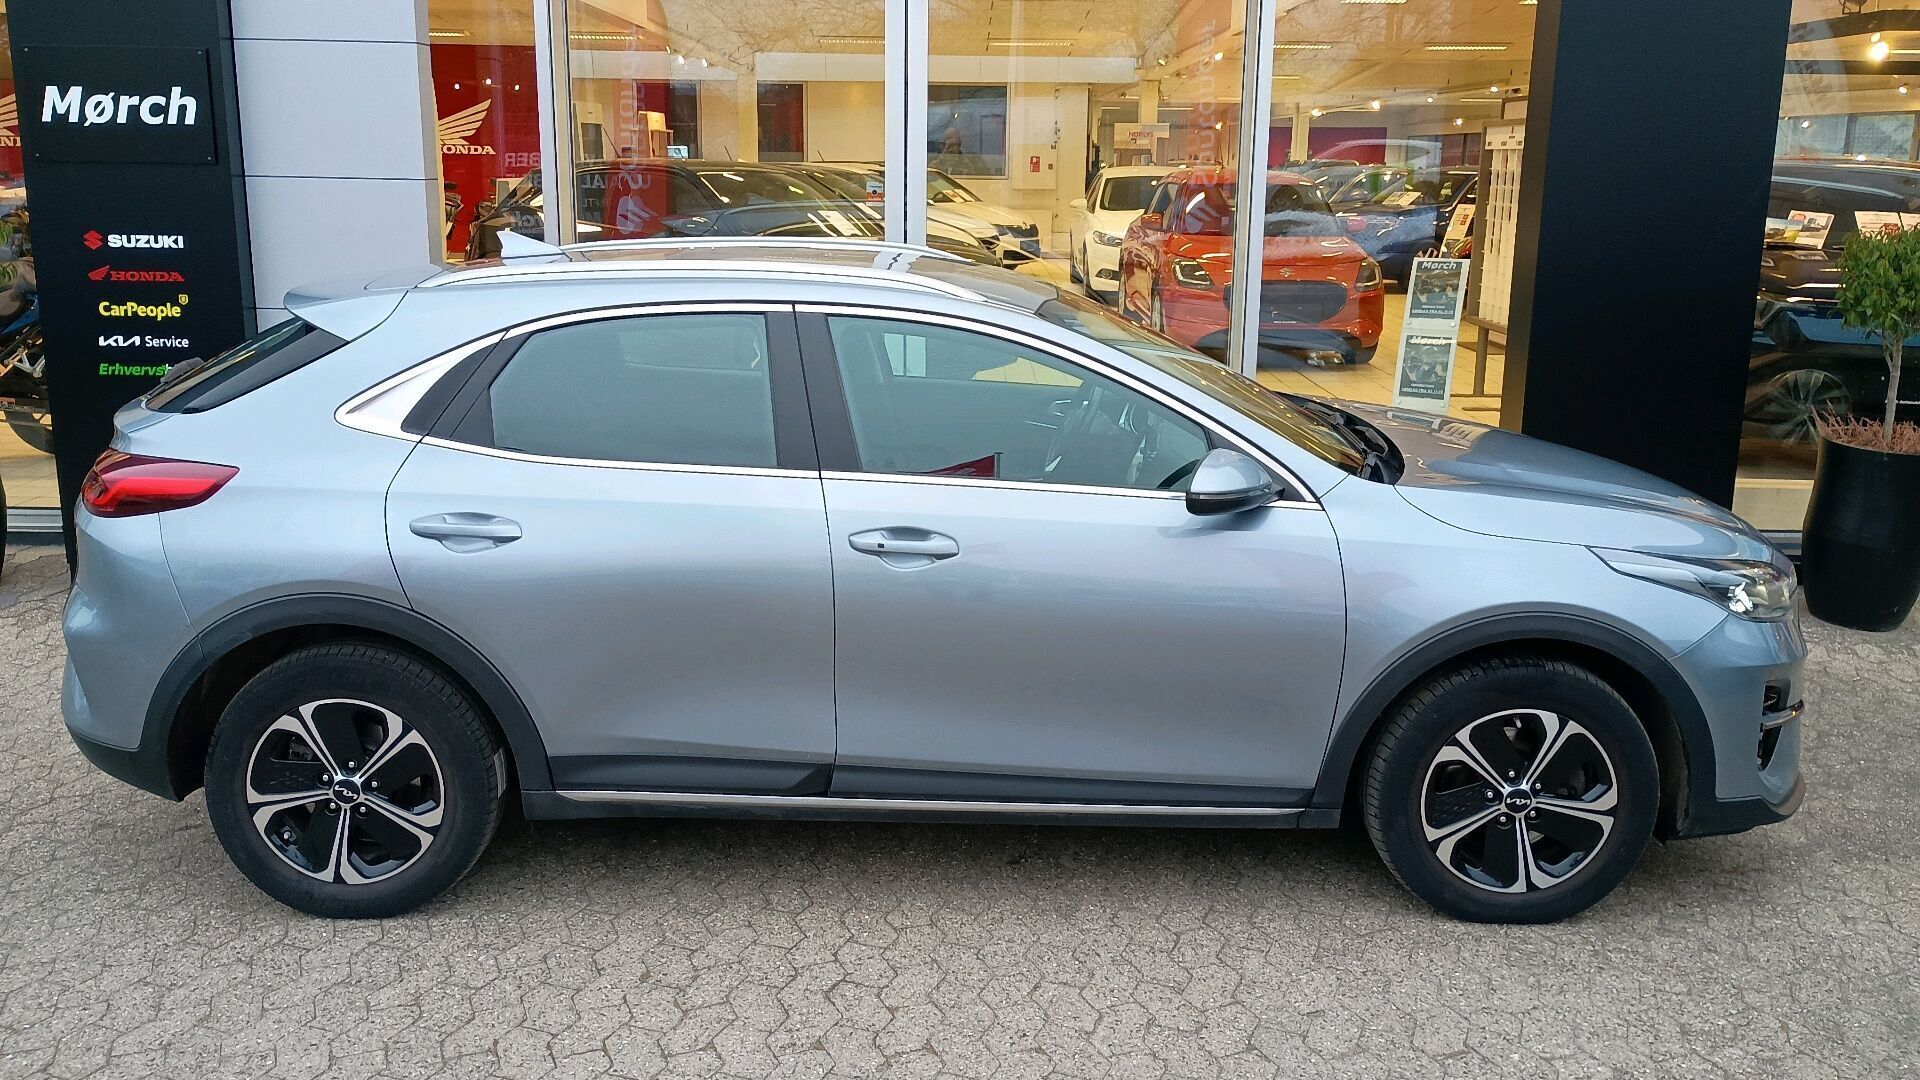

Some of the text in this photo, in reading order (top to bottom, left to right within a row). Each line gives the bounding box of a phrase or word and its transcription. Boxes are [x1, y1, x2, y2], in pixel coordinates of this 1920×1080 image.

[41, 85, 198, 127] Mørch
[440, 144, 496, 155] ONDA
[107, 234, 184, 249] SUZUKI
[110, 271, 185, 282] HONDA
[98, 301, 181, 321] CarPeople
[144, 335, 189, 348] Service
